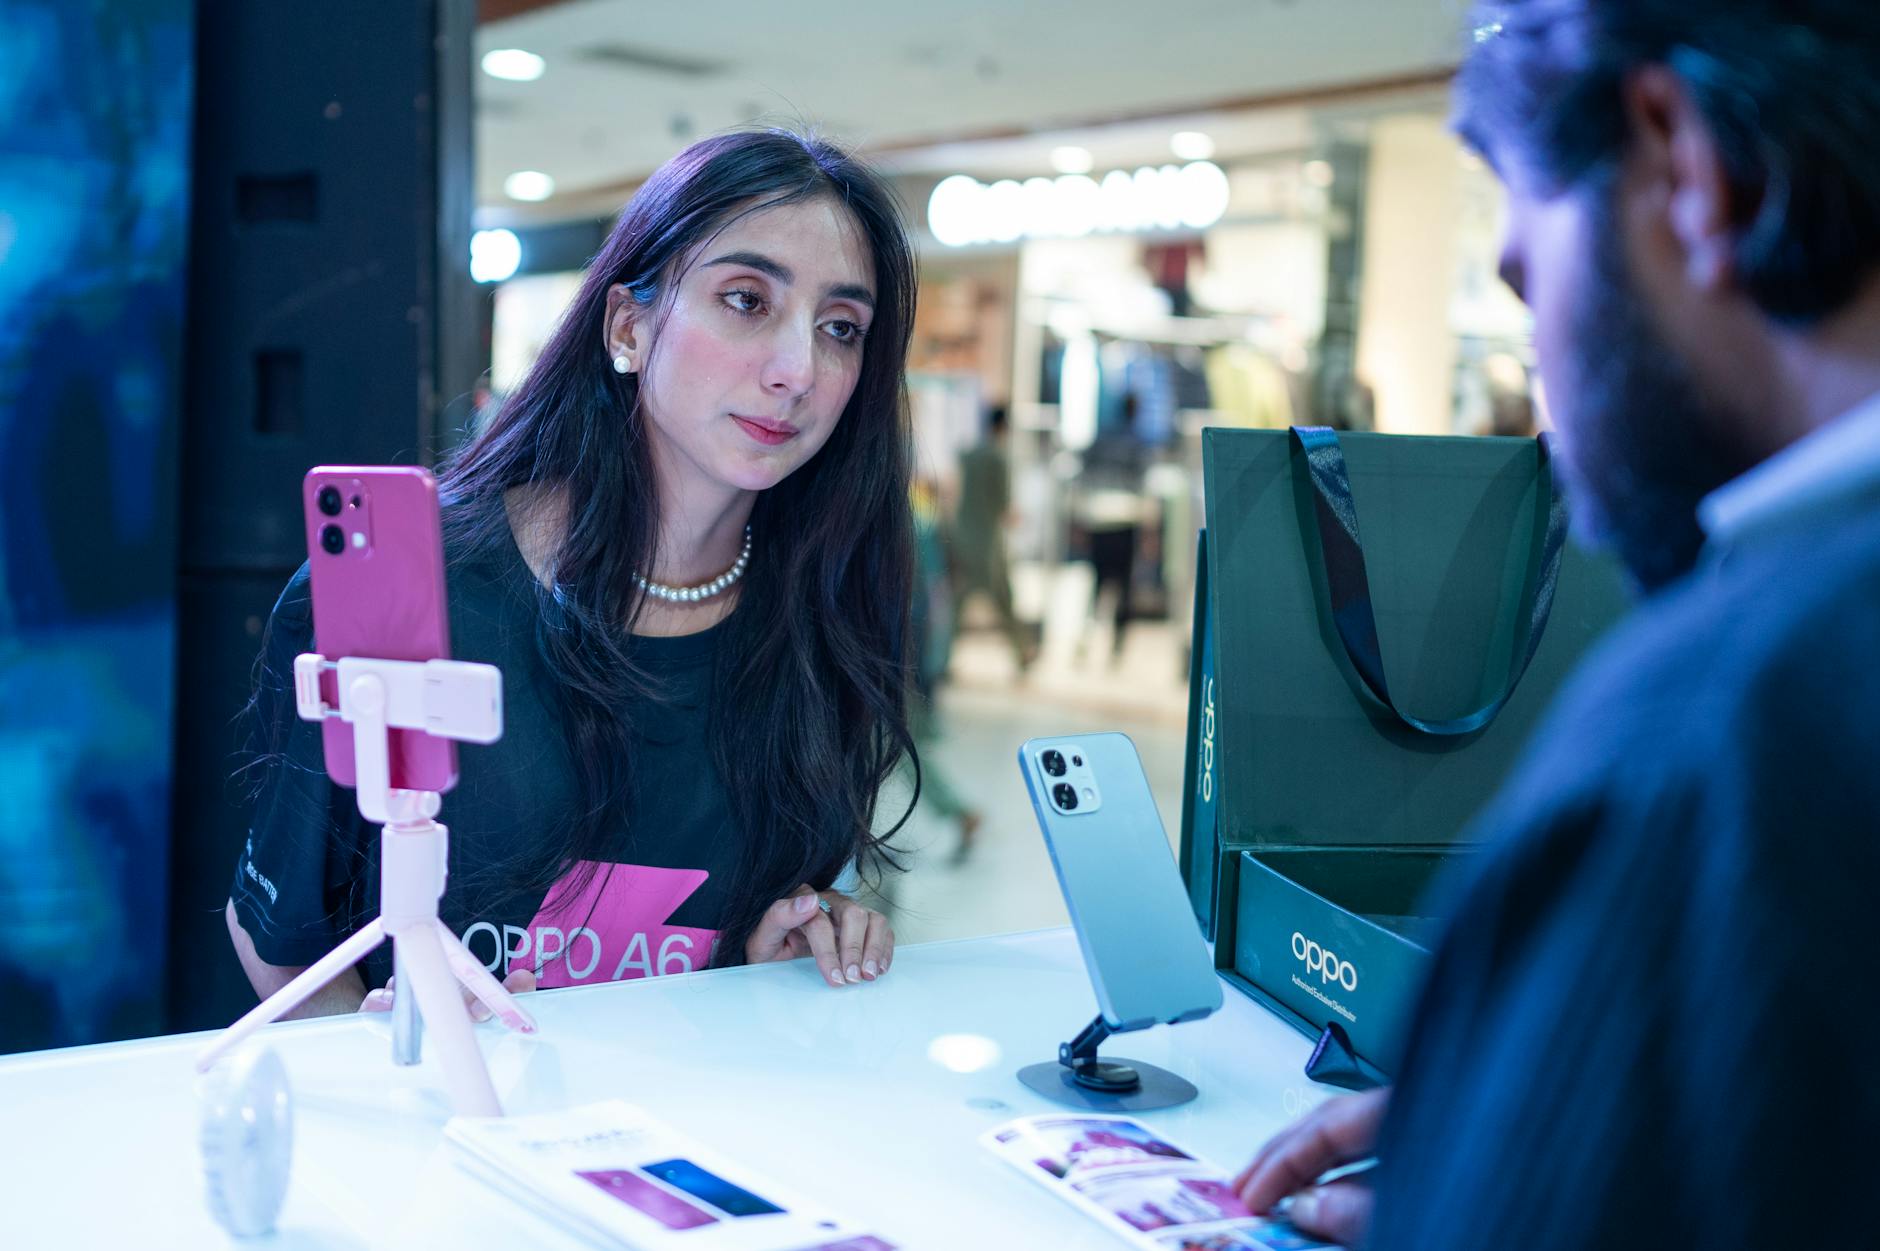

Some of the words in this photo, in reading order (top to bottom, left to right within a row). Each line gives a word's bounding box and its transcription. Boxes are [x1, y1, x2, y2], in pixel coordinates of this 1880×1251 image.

[461, 921, 602, 980] OPPO
[611, 932, 695, 981] A6
[1291, 931, 1358, 992] oppo
